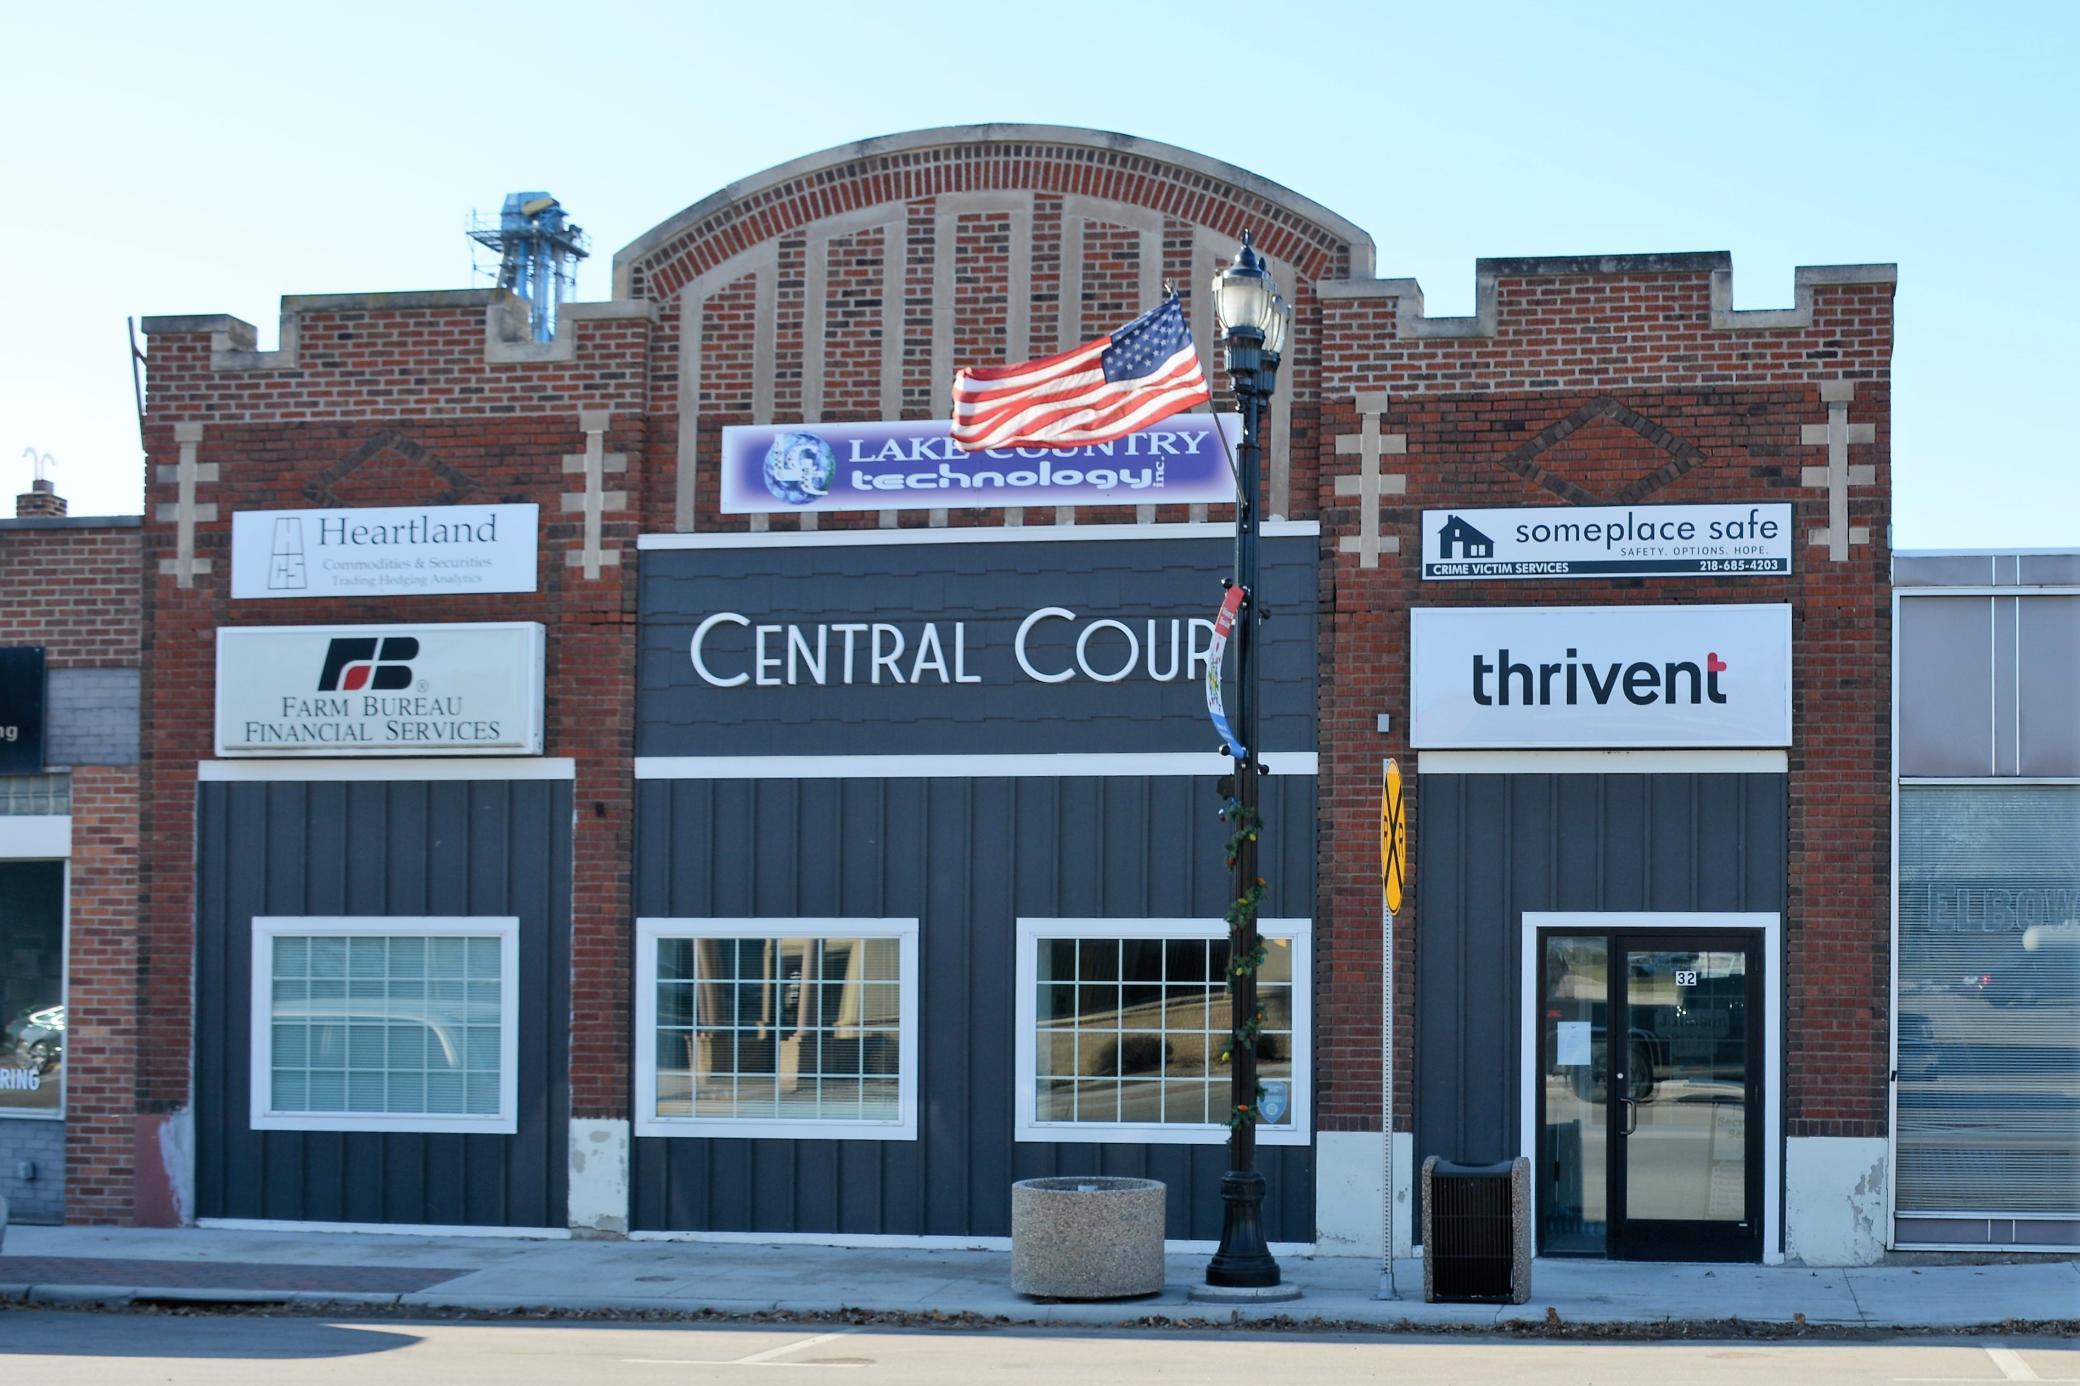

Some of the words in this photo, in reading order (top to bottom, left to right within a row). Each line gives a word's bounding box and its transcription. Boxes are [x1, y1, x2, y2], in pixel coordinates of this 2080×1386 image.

[849, 437, 970, 462] LAKE
[852, 461, 1152, 490] technology
[1153, 456, 1165, 488] inc.
[318, 513, 499, 546] Heartland
[1516, 511, 1695, 550] someplace
[1709, 509, 1778, 540] safe
[1620, 547, 1668, 557] SAFETY.
[1673, 546, 1729, 556] OPTIONS.
[1734, 545, 1769, 555] HOPE.
[322, 558, 411, 571] Commodities
[414, 557, 426, 569] &
[429, 556, 493, 570] Securities
[1432, 564, 1469, 576] CRIME
[1471, 563, 1513, 575] VICTIM
[1515, 562, 1569, 574] SERVICES
[1699, 560, 1779, 571] 218-685-4203
[332, 575, 376, 587] Trading
[379, 574, 427, 587] Hedging
[430, 573, 483, 587] Analytics
[690, 611, 983, 688] CENTRAL
[1014, 606, 1261, 684] COUR
[1472, 648, 1728, 706] thrivent
[281, 696, 349, 718] FARM
[363, 696, 462, 717] BUREAU
[245, 721, 373, 742] FINANCIAL
[385, 720, 500, 741] SERVICES
[1677, 972, 1695, 984] 32
[0, 1067, 40, 1090] RING
